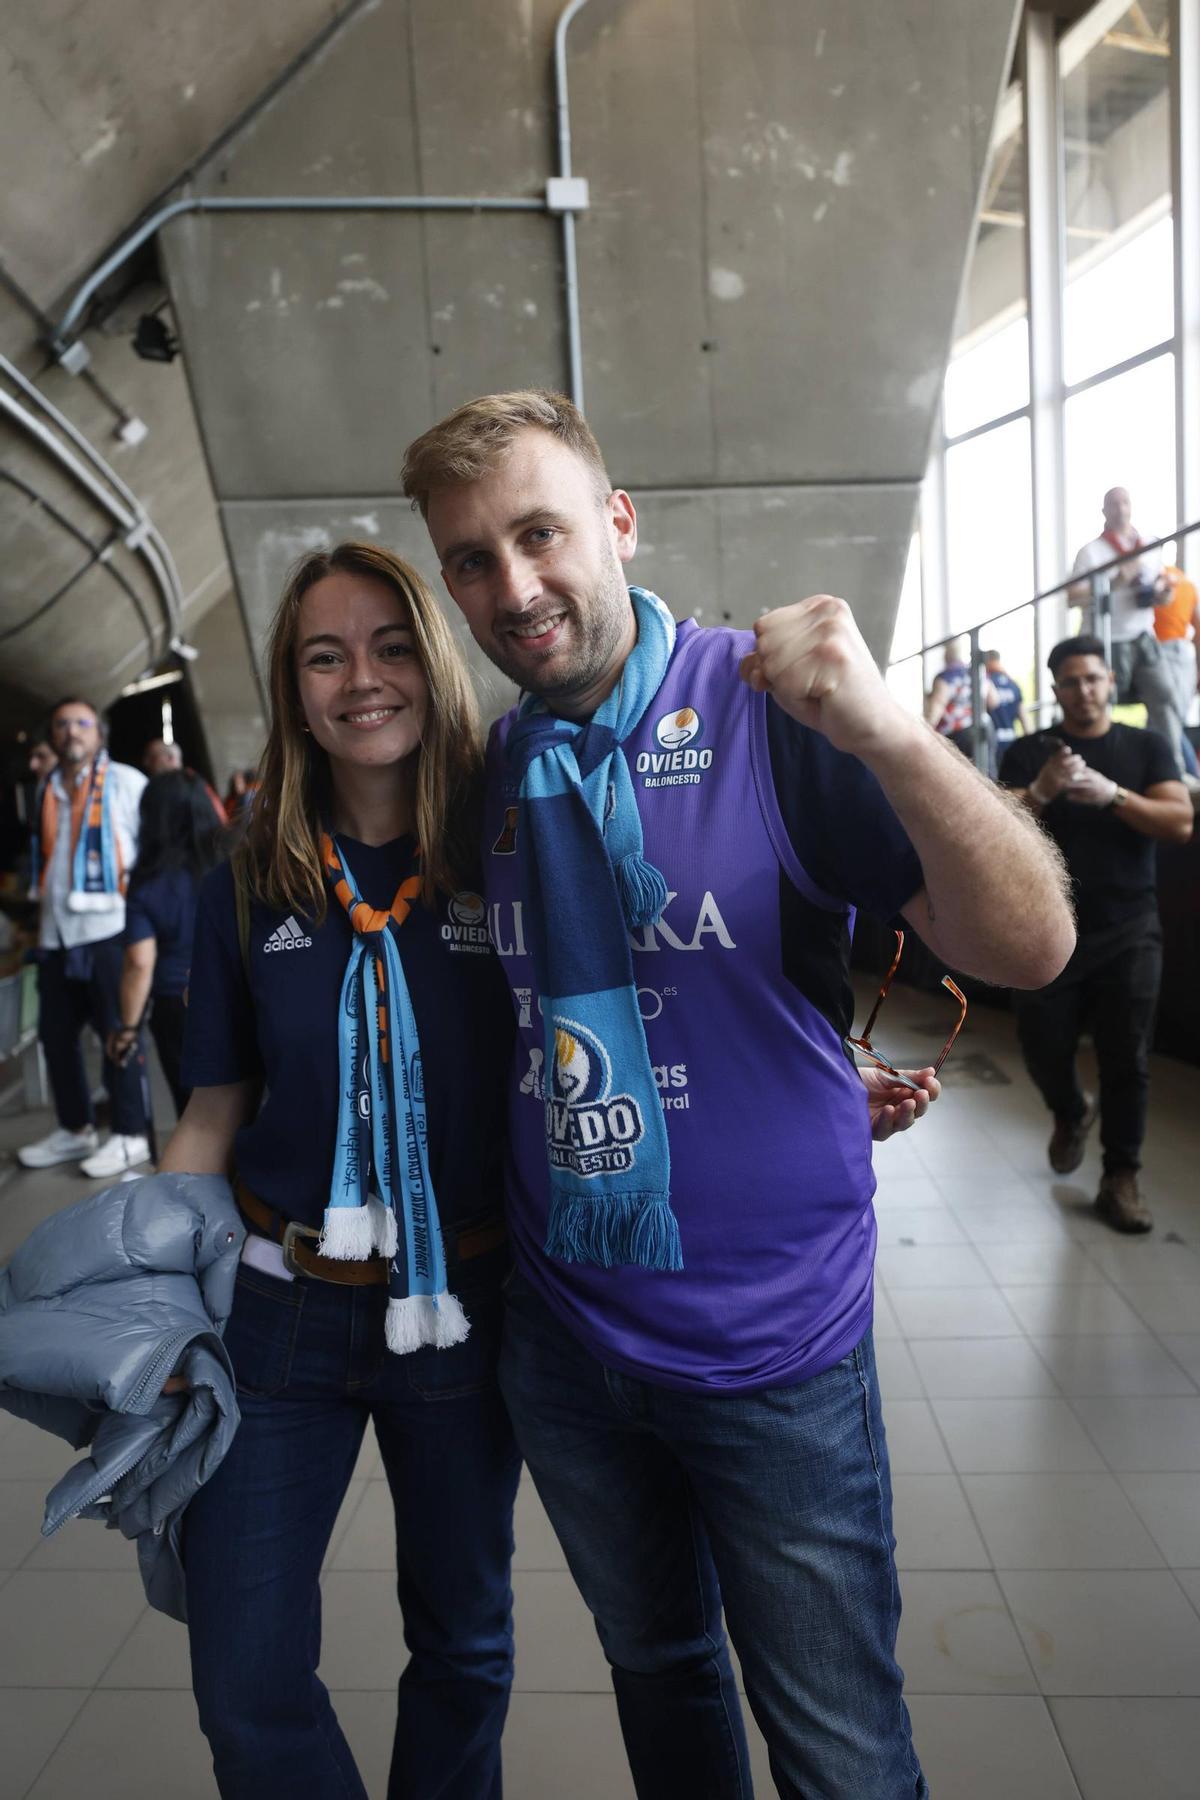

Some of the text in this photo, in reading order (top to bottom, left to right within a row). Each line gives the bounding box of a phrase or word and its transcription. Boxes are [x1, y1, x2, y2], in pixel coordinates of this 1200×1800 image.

[636, 749, 713, 773] OVIEDO
[645, 774, 701, 788] BALONCESTO
[263, 935, 313, 953] adidas
[441, 924, 493, 944] OVIED
[450, 943, 490, 955] BALONCESTO
[545, 1102, 637, 1148] OVEDO
[341, 1127, 360, 1197] OGENSA
[549, 1148, 628, 1173] ALOESTO
[410, 1191, 426, 1224] JAVIER
